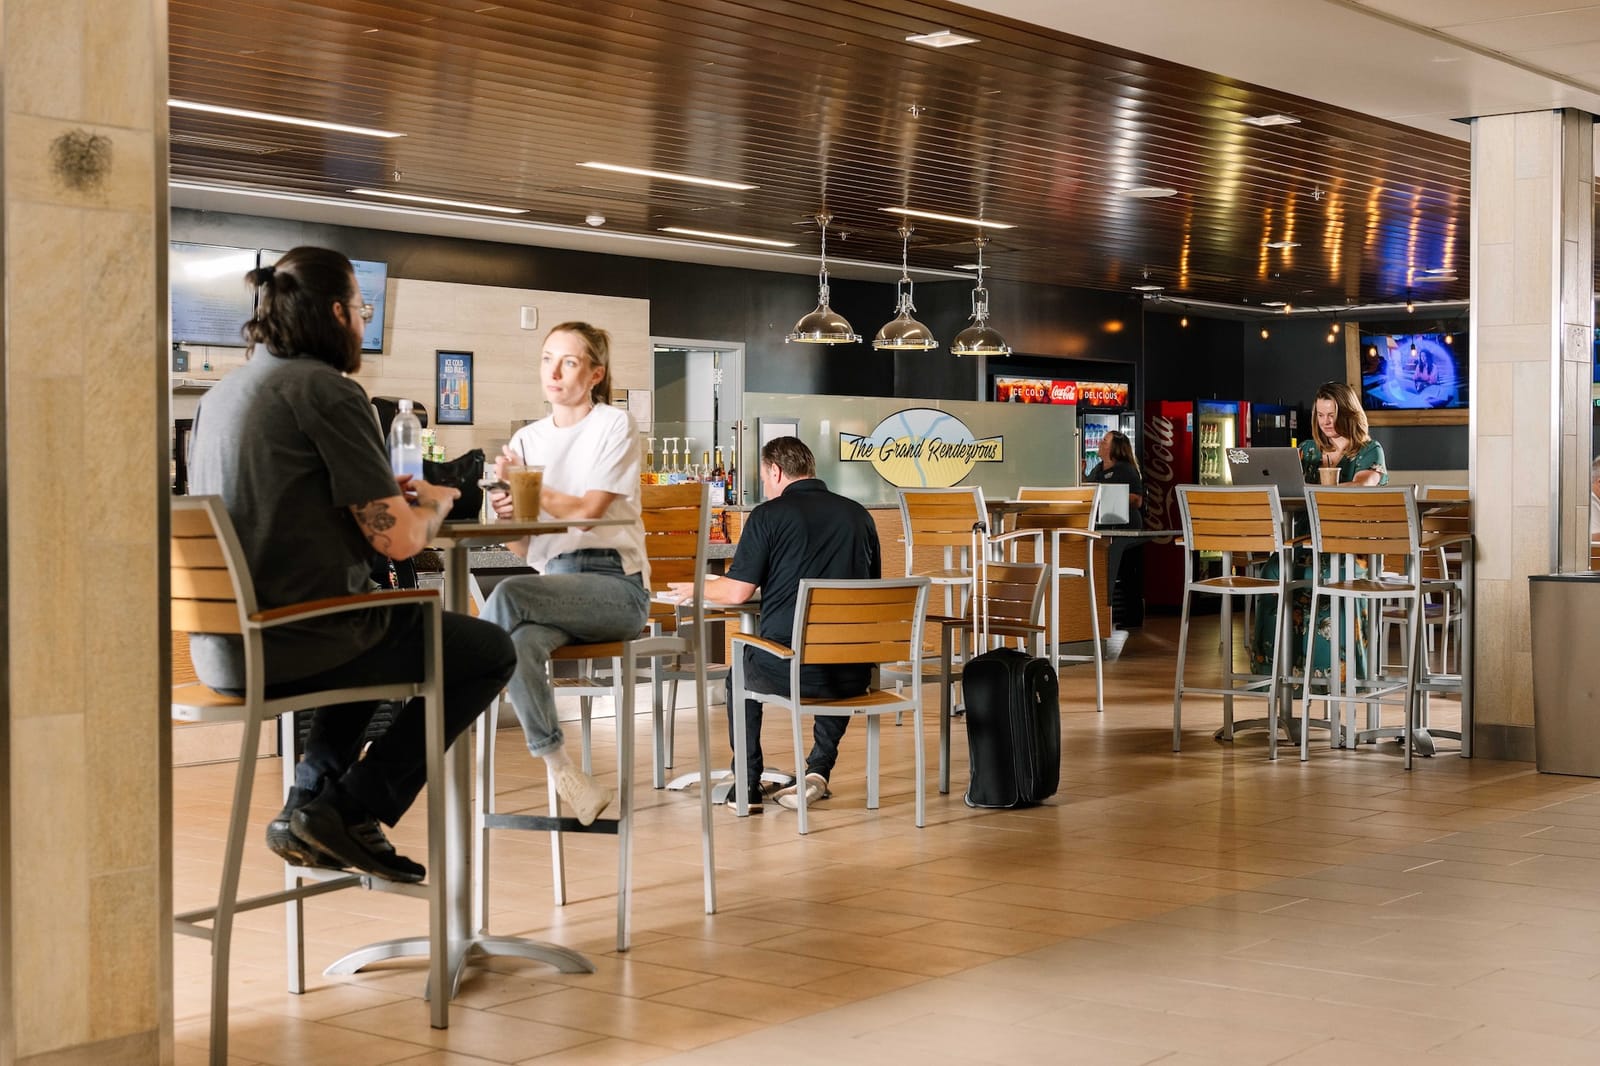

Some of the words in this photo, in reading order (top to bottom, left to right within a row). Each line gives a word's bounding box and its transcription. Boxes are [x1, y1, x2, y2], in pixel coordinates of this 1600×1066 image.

[1025, 388, 1045, 397] COLD
[1051, 385, 1076, 400] Coca-Cola
[1084, 391, 1118, 400] DELICIOUS
[849, 436, 874, 460] The
[879, 436, 926, 462] Grand
[927, 437, 998, 464] Rendezvous
